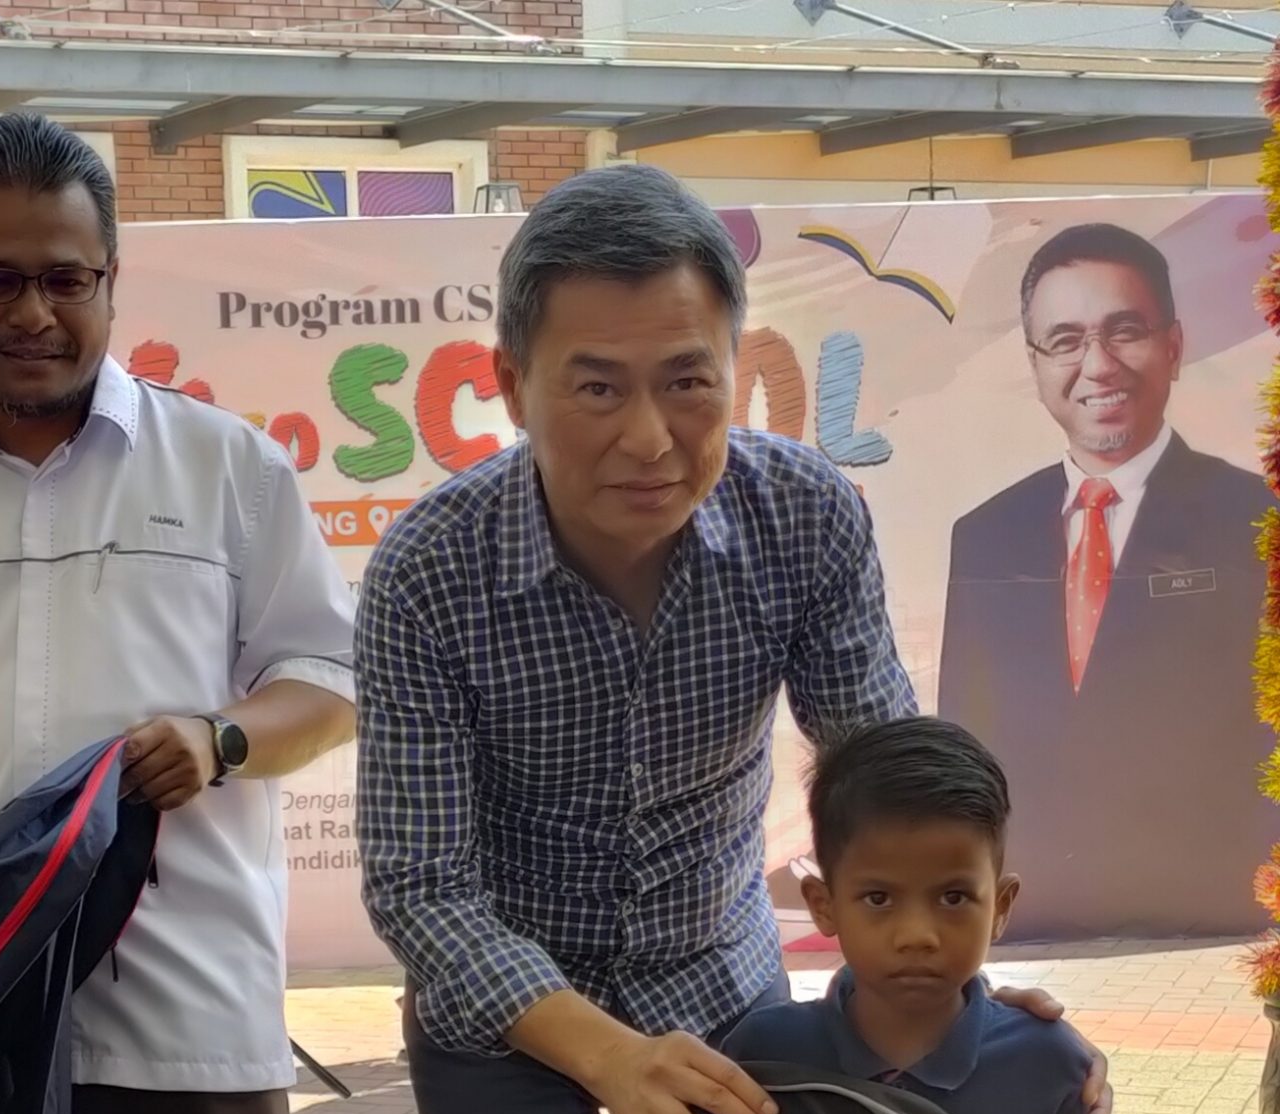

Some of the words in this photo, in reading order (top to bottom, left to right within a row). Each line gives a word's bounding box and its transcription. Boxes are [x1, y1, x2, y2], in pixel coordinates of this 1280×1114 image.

[217, 291, 423, 340] Program
[432, 284, 496, 323] CS
[329, 326, 894, 484] SCOL
[312, 510, 358, 537] NG
[319, 820, 357, 840] Ra
